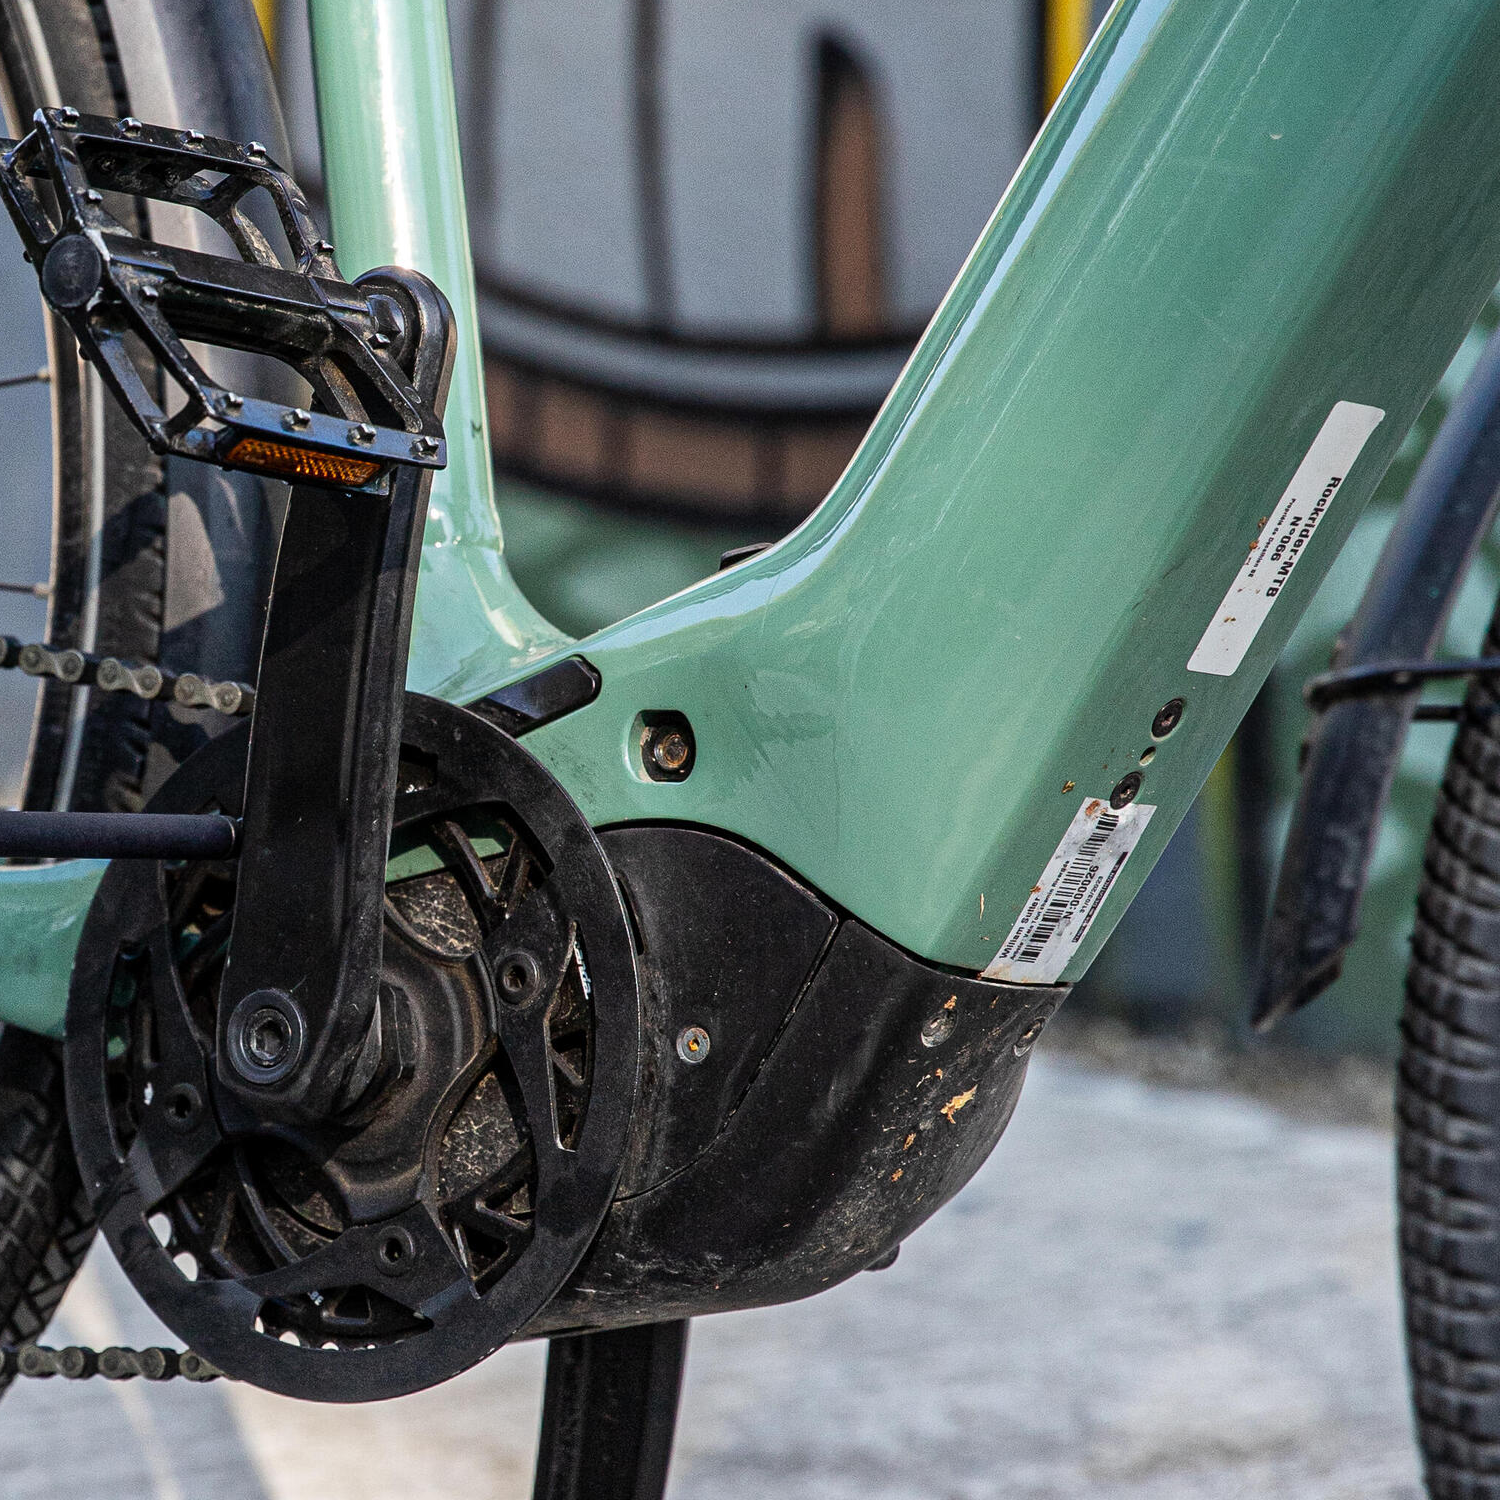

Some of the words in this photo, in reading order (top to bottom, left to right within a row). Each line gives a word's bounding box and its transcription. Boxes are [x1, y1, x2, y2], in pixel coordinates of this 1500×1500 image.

[1266, 476, 1342, 597] Rockrider-MTB
[1063, 865, 1099, 919] N:000026
[999, 926, 1025, 959] William
